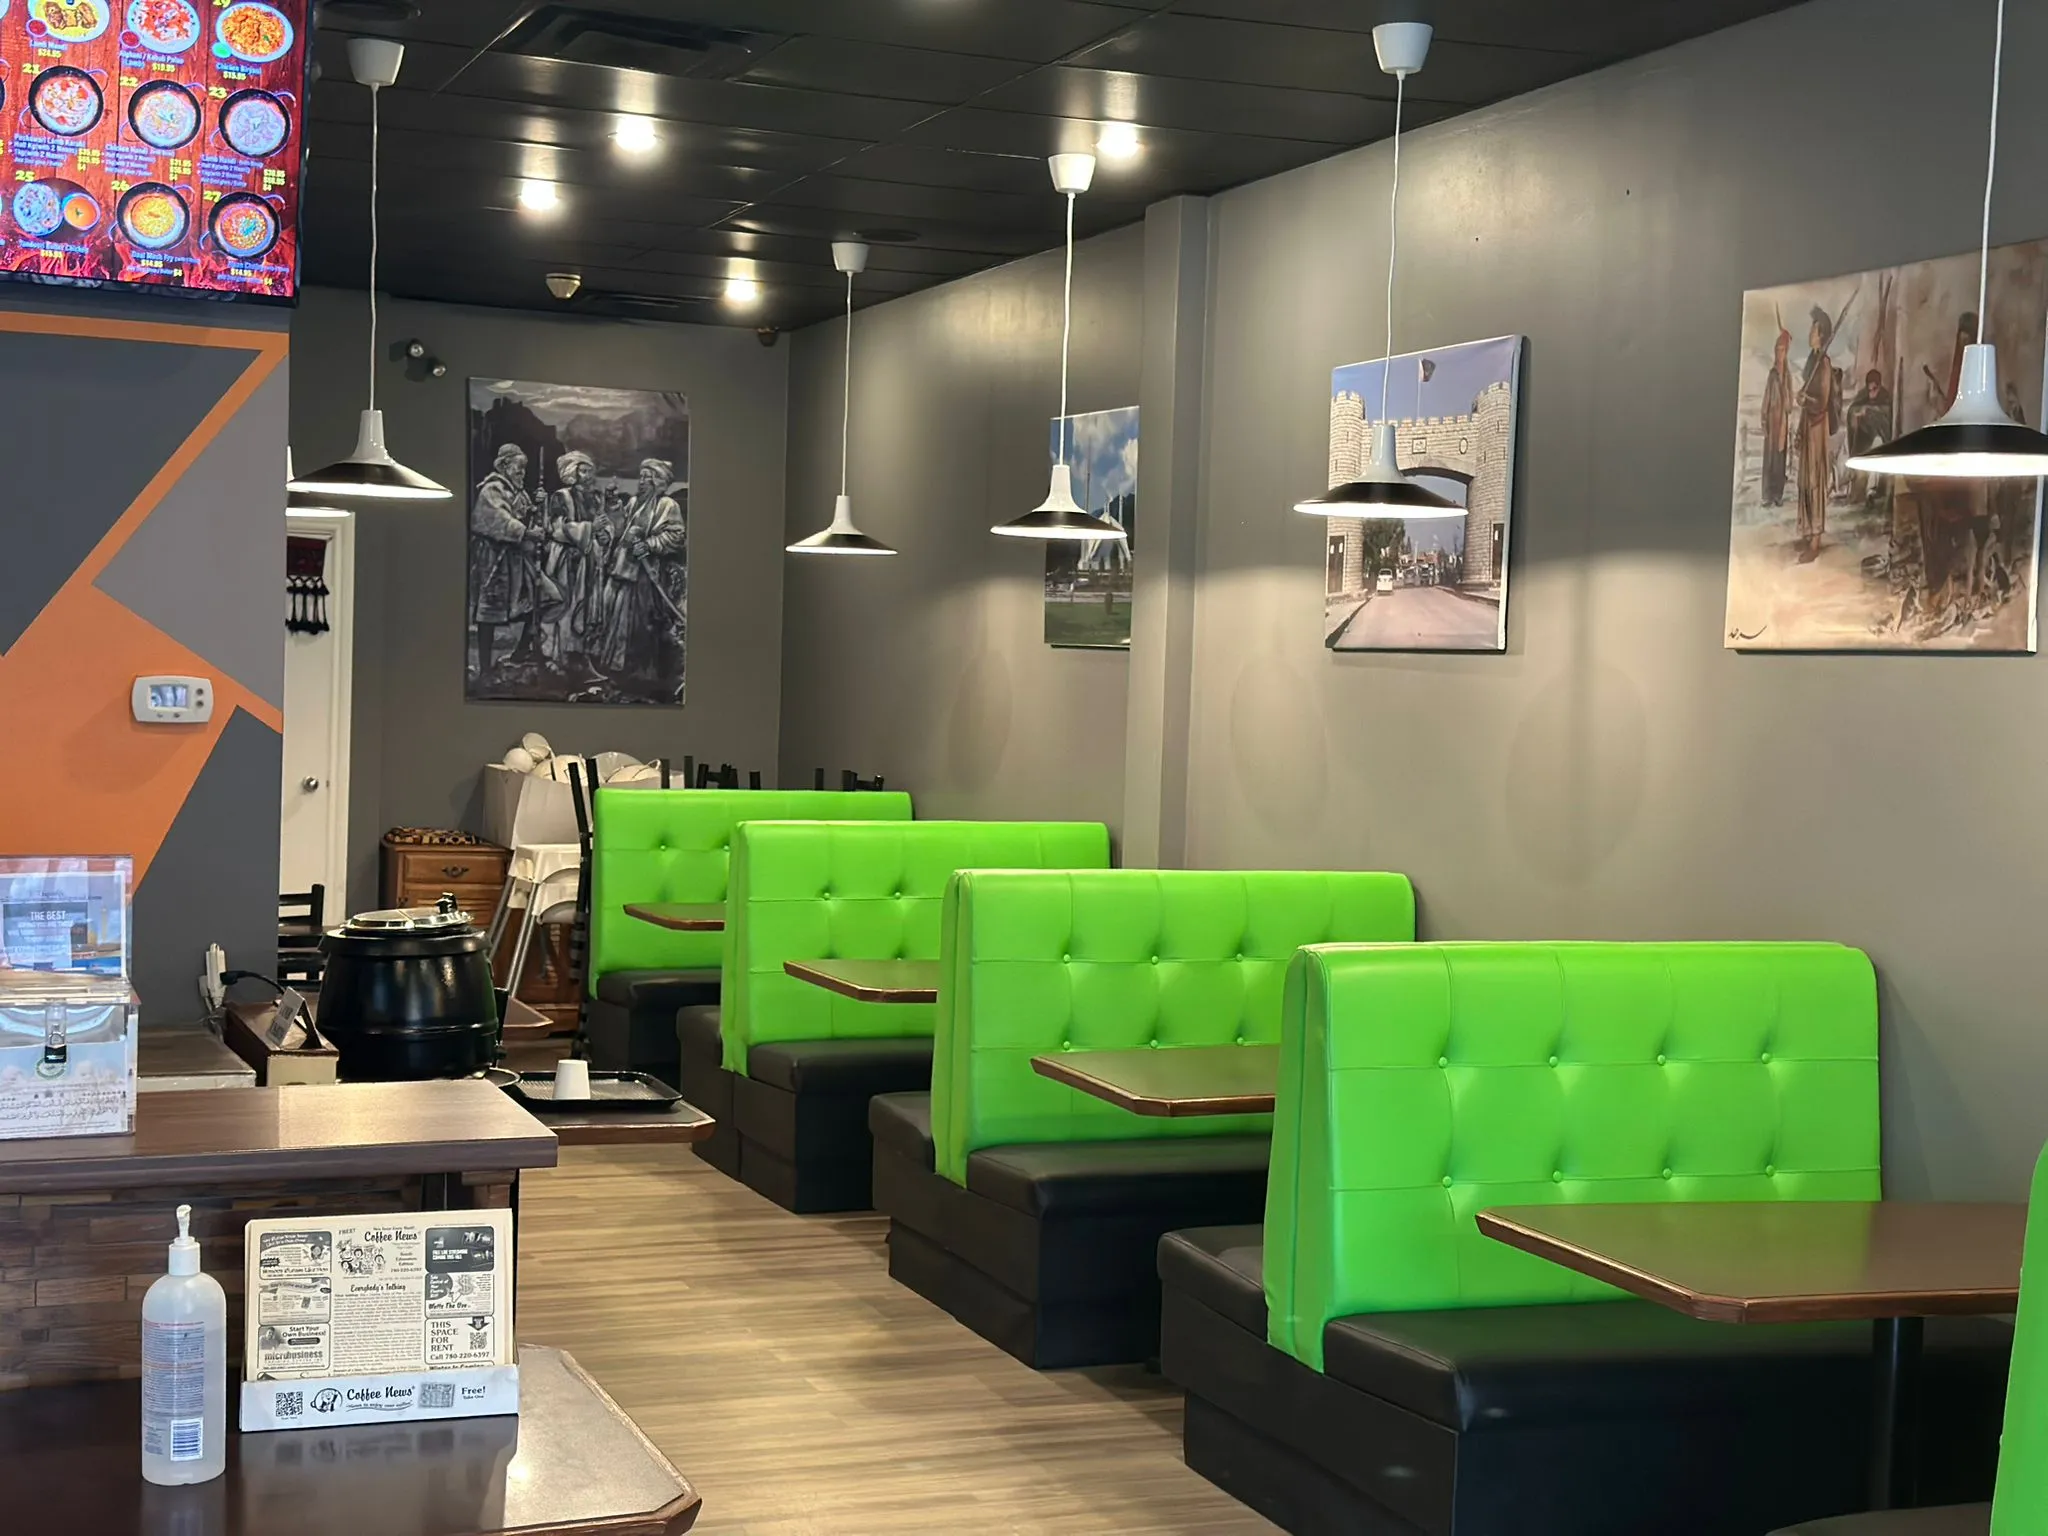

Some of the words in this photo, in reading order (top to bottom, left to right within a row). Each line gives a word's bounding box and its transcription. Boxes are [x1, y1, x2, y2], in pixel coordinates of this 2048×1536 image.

[22, 63, 41, 74] 21
[120, 76, 138, 87] 22
[208, 86, 227, 99] 23
[16, 170, 35, 182] 25
[111, 180, 130, 191] 26
[203, 190, 222, 202] 27
[31, 911, 45, 920] THE
[47, 910, 66, 920] BEST
[364, 1231, 393, 1243] Coffee
[395, 1230, 418, 1241] News
[430, 1328, 459, 1336] SPACE
[431, 1336, 449, 1344] FOR
[264, 1351, 323, 1361] microbusiness
[445, 1352, 490, 1360] 780-220-6397
[346, 1388, 381, 1402] Coffee
[385, 1385, 413, 1398] News
[461, 1385, 486, 1395] Free!
